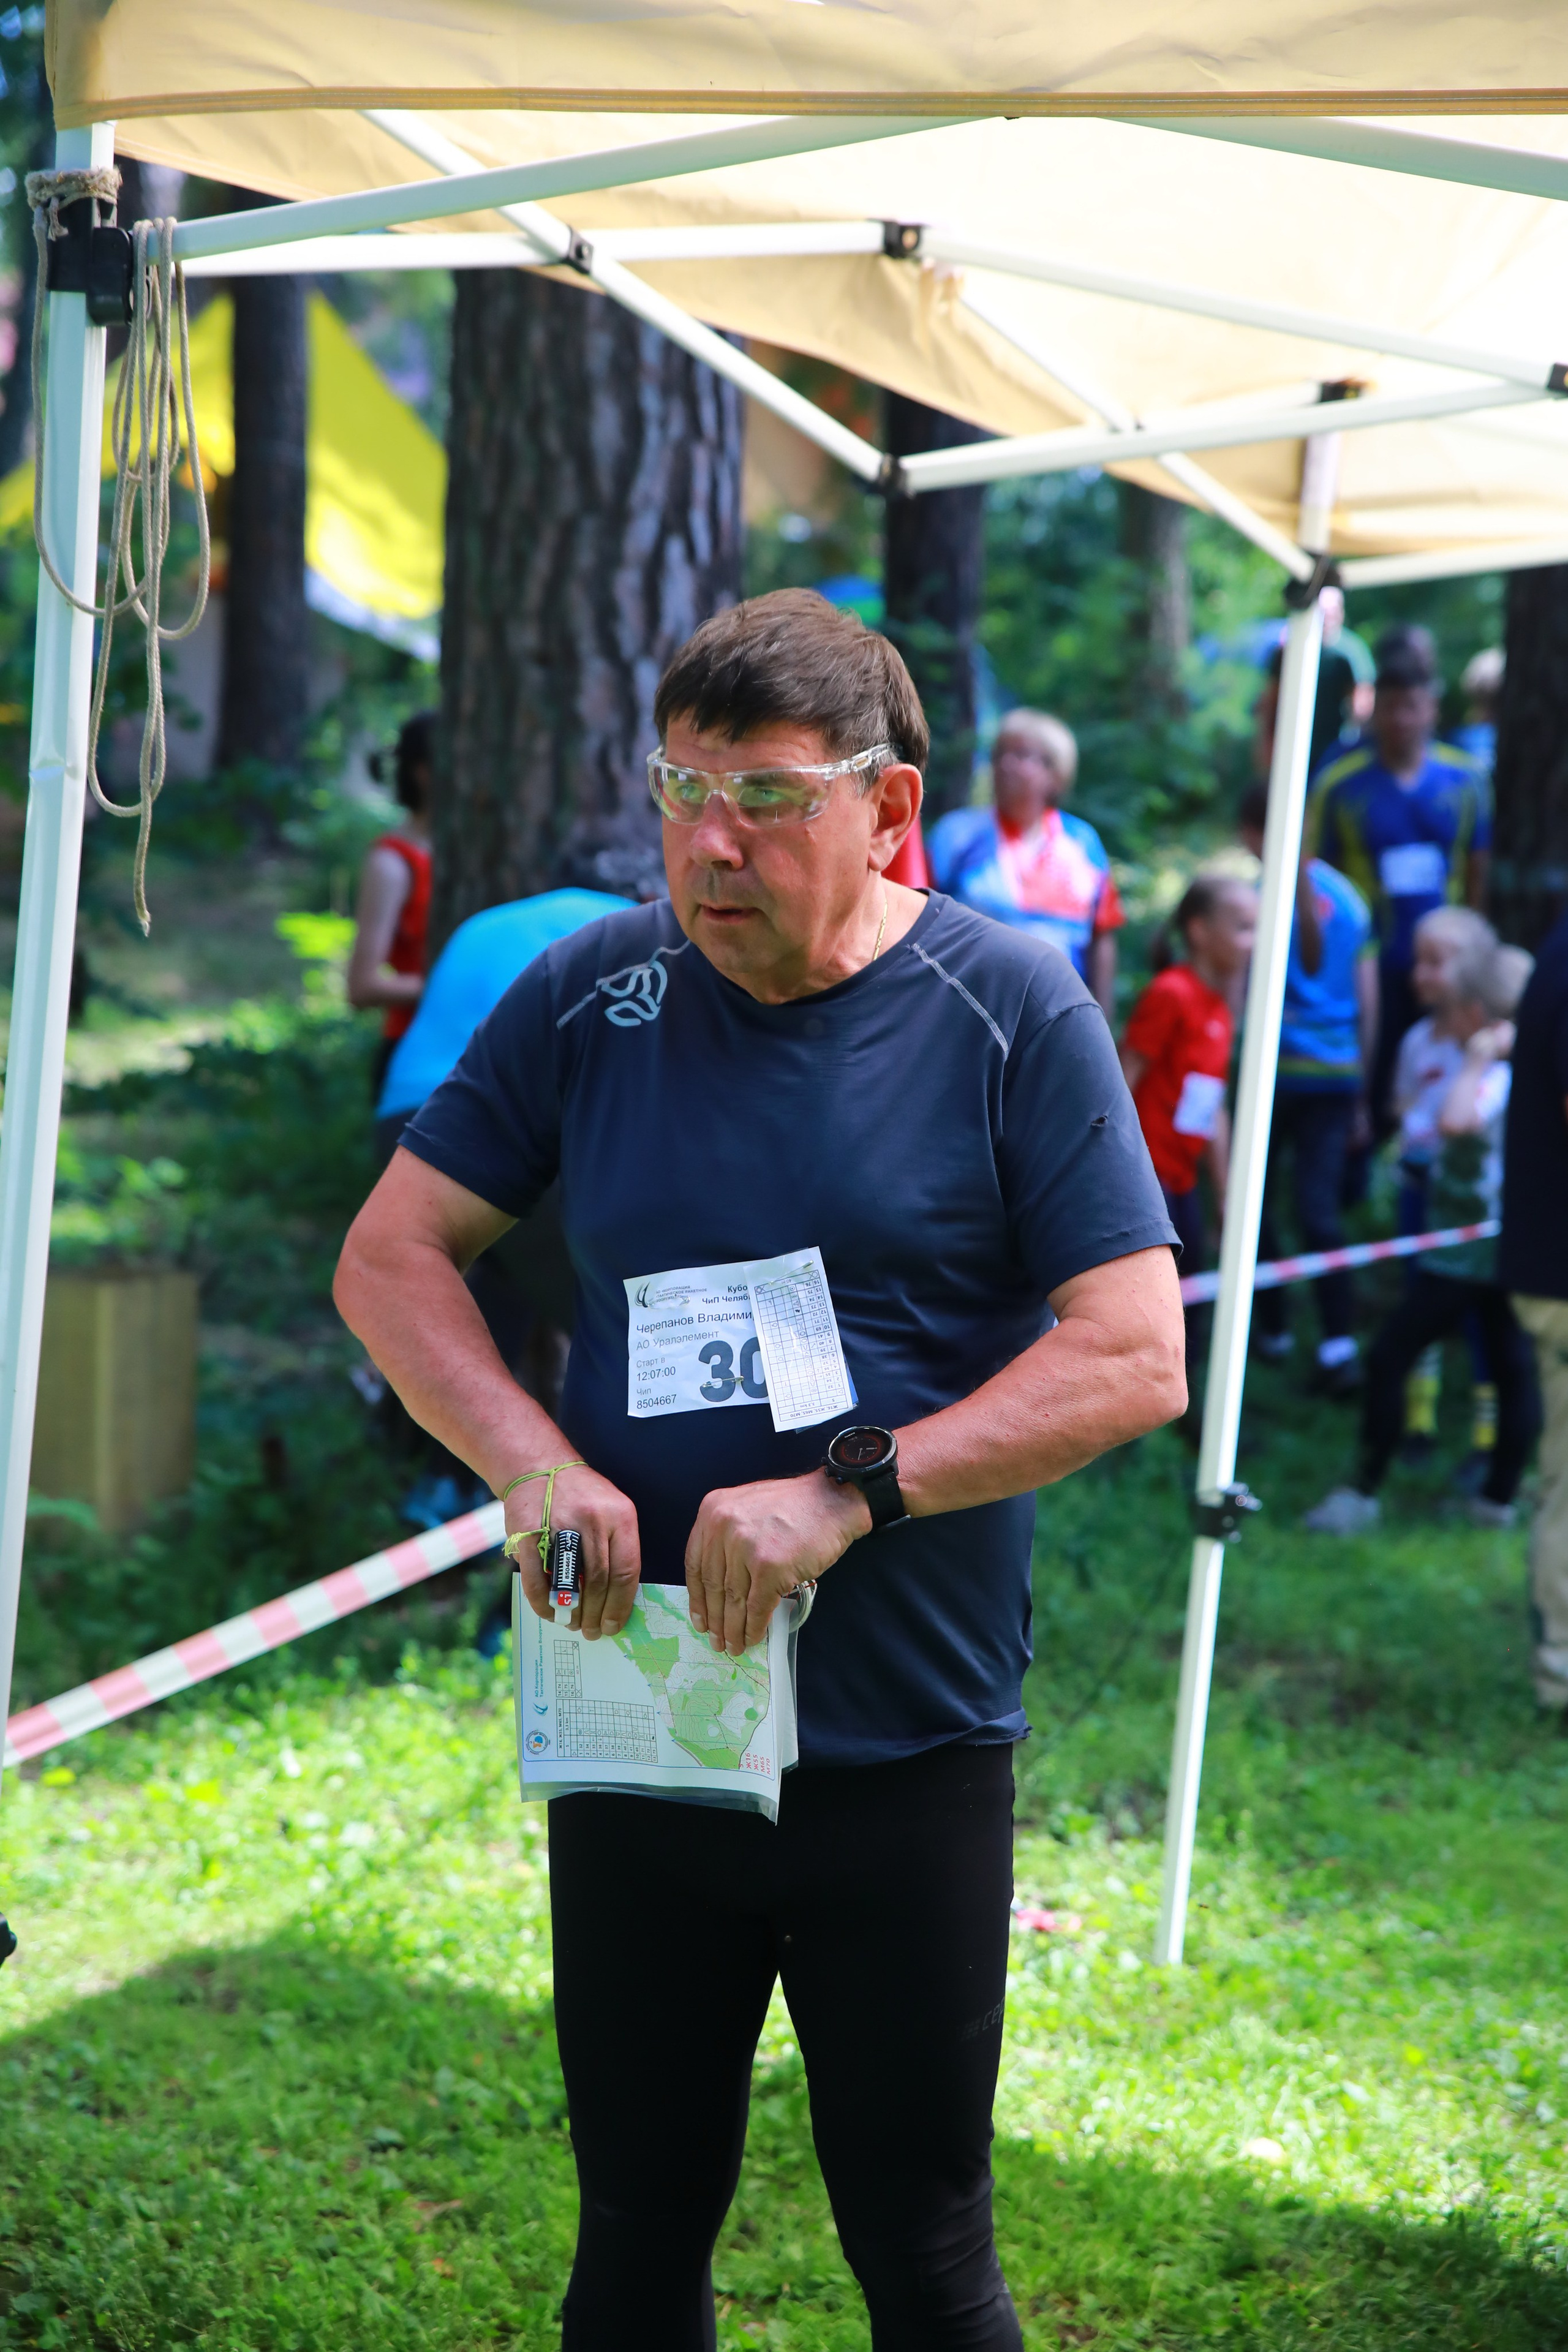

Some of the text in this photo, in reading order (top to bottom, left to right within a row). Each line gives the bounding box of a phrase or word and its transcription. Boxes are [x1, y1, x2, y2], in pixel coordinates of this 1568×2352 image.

[636, 1311, 754, 1334] Черепанов Владими
[636, 1331, 720, 1351] АО Уралэлемент
[636, 1358, 658, 1368] Старт
[636, 1366, 676, 1381] 12:07:00
[636, 1387, 652, 1396] Чип
[636, 1394, 677, 1409] 8504667
